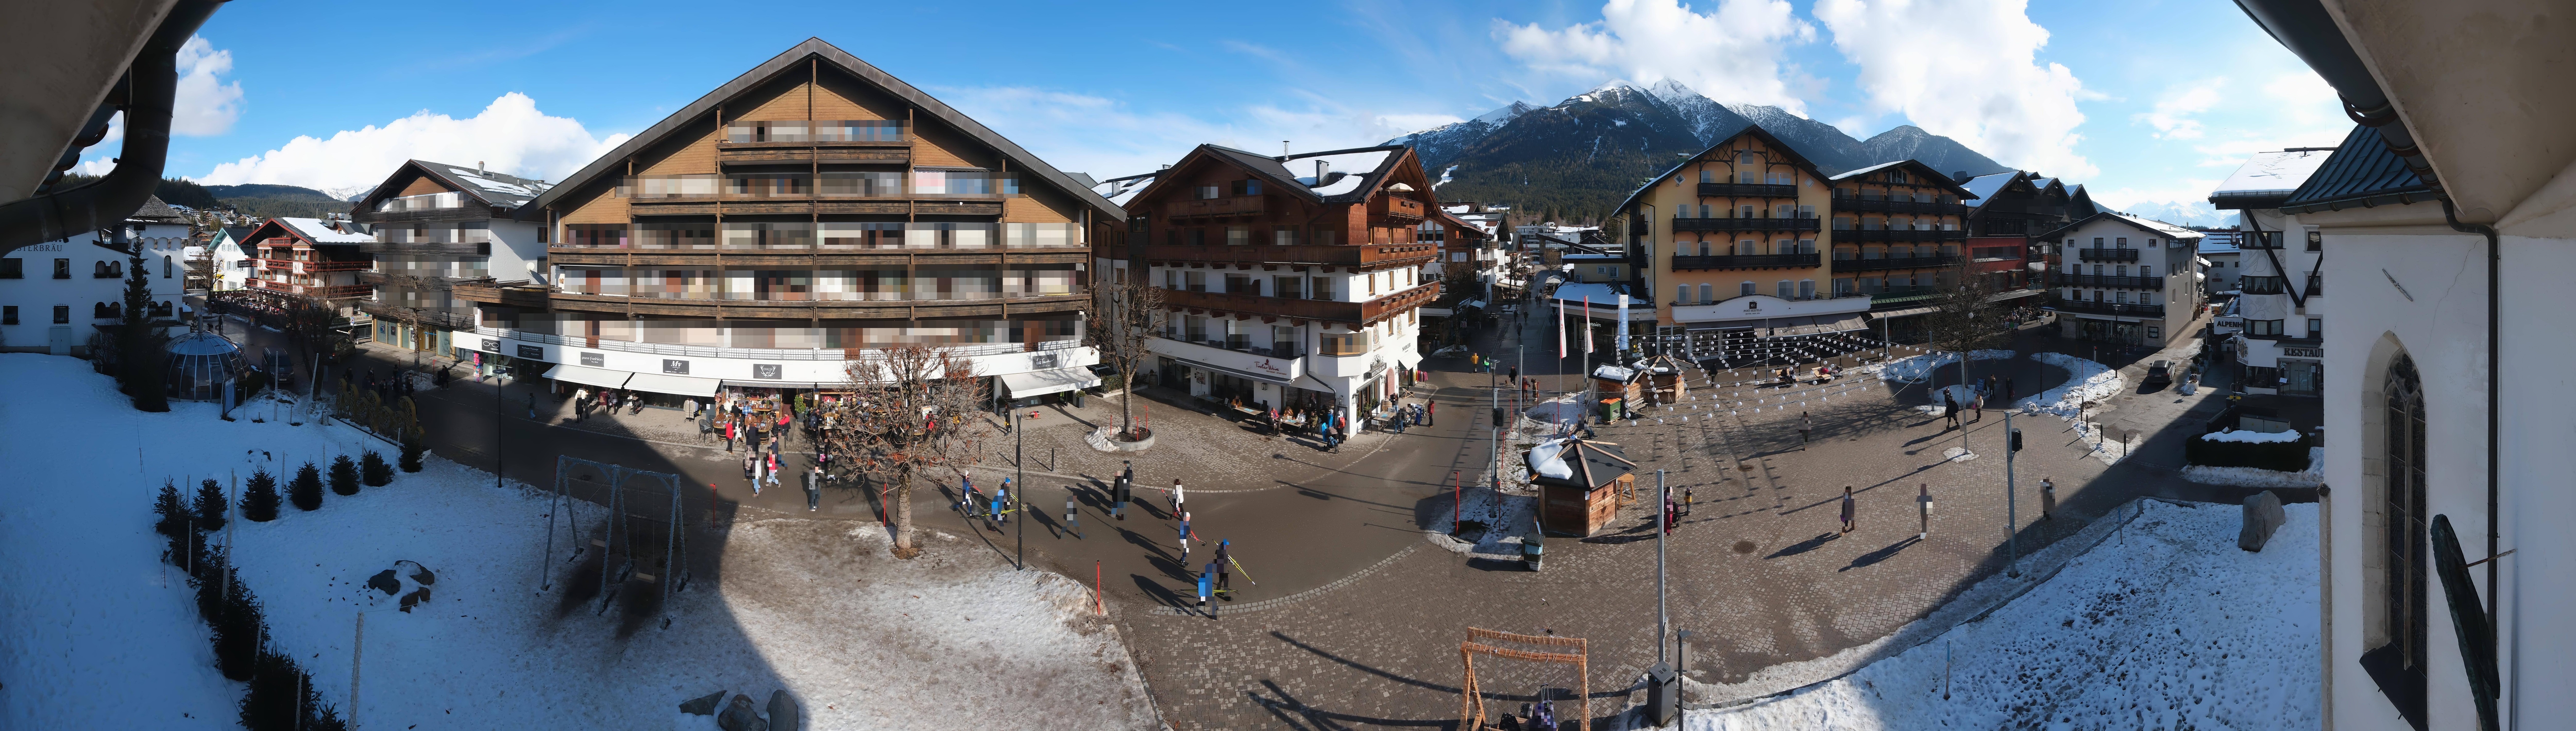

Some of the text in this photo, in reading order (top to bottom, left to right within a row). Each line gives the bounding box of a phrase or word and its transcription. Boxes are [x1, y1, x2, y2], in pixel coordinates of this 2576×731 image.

[1402, 343, 1411, 351] SAILER
[2238, 355, 2248, 364] Kaltschmid
[1372, 364, 1386, 377] RESTAURANT
